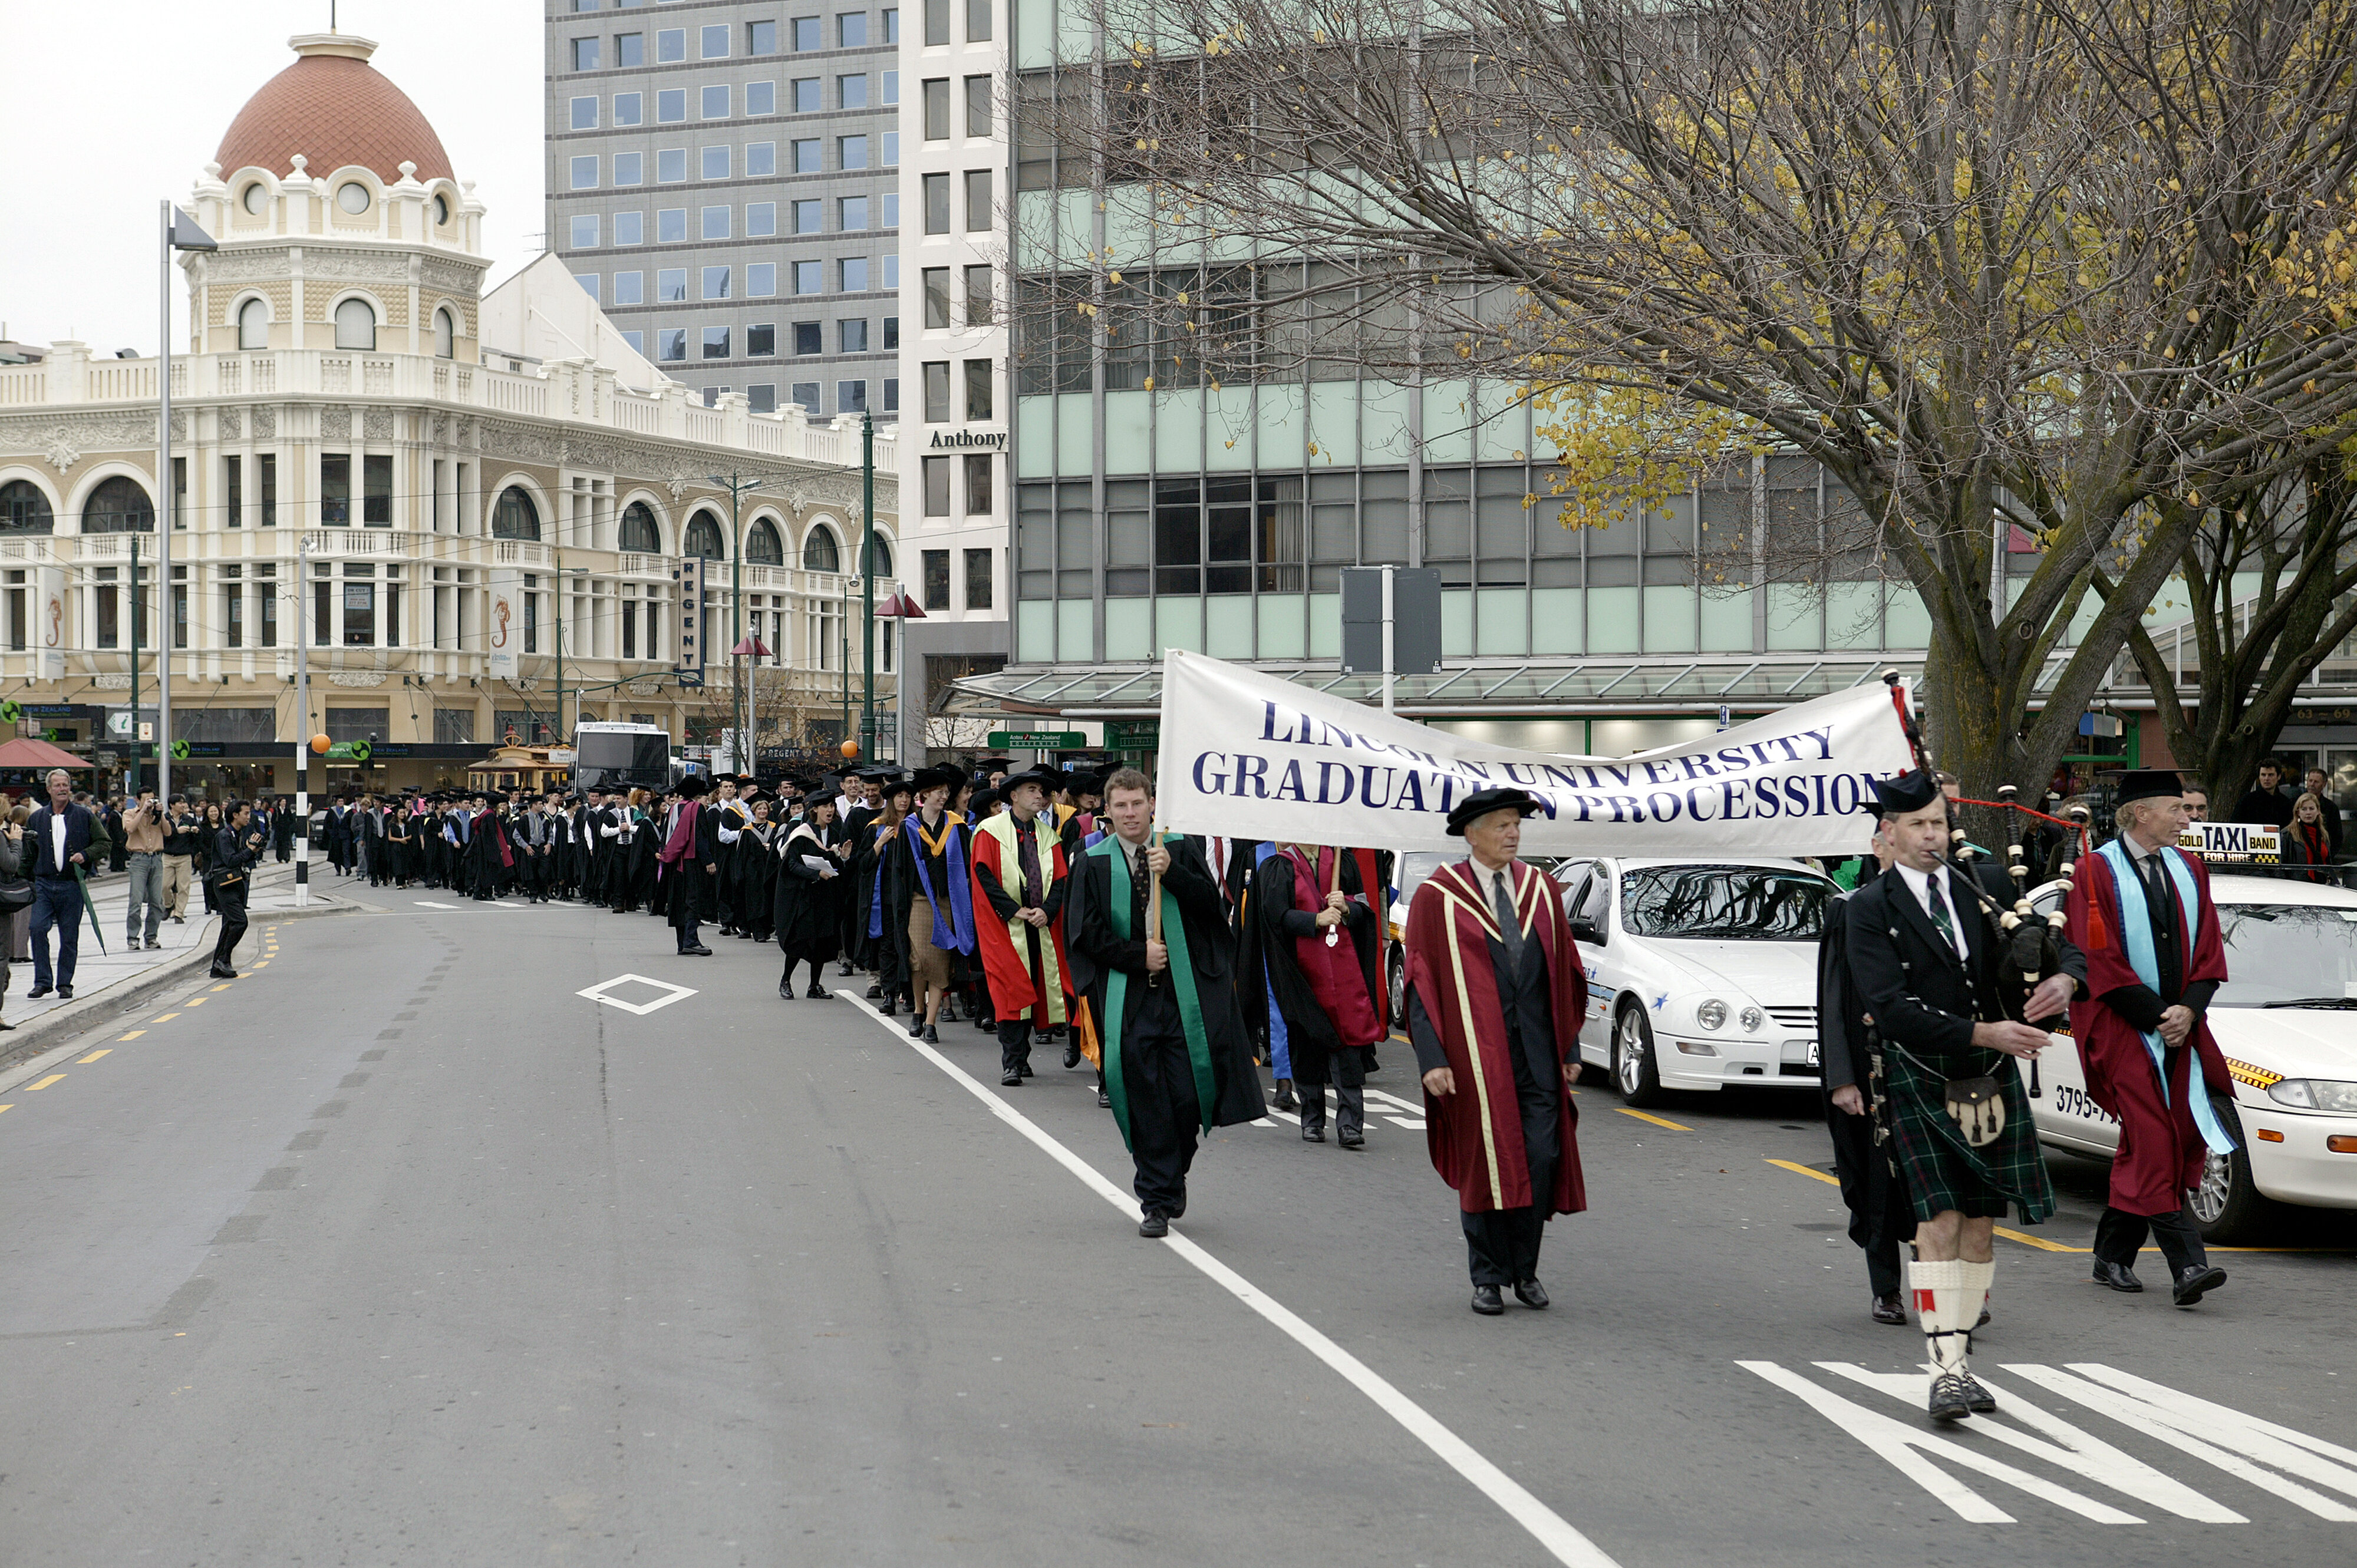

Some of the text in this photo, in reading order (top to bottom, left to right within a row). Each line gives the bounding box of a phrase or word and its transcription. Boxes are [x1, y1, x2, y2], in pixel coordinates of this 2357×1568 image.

[929, 429, 1006, 450] Anthony
[683, 563, 694, 665] REGENT
[2297, 709, 2313, 719] 63
[2334, 708, 2351, 719] 69
[768, 749, 800, 758] REGENT
[1258, 699, 1835, 788] LINCOLN UNIVERSITY
[1192, 751, 1891, 822] GRADUATN PROCESSION
[2178, 826, 2276, 852] GOLD TAXI BAND
[2203, 852, 2251, 863] FOR HIRE
